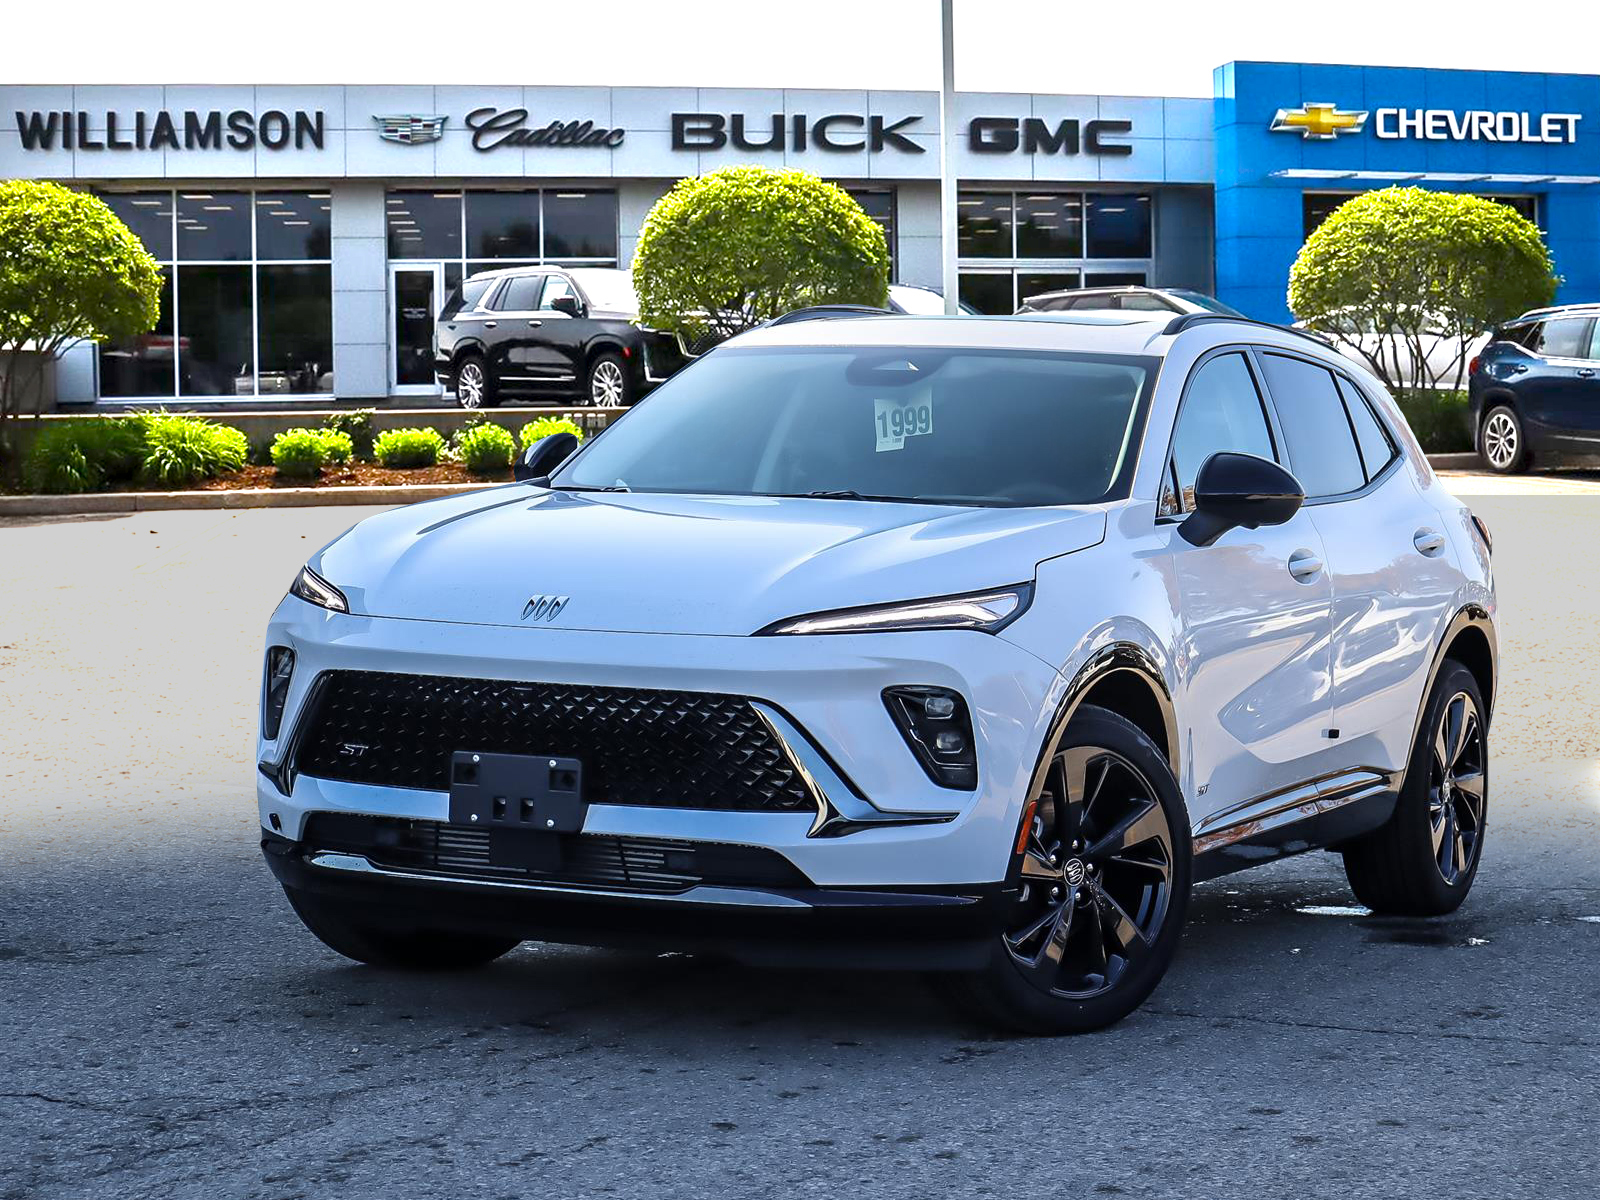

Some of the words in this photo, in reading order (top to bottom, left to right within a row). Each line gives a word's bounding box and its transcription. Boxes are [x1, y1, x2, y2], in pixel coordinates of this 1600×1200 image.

[16, 111, 324, 150] WILLIAMSON
[465, 107, 625, 151] Cadillac
[671, 112, 926, 153] BUICK
[970, 116, 1132, 155] GMC
[1376, 107, 1582, 143] CHEVROLET
[877, 405, 930, 438] 1999
[340, 743, 369, 757] ST
